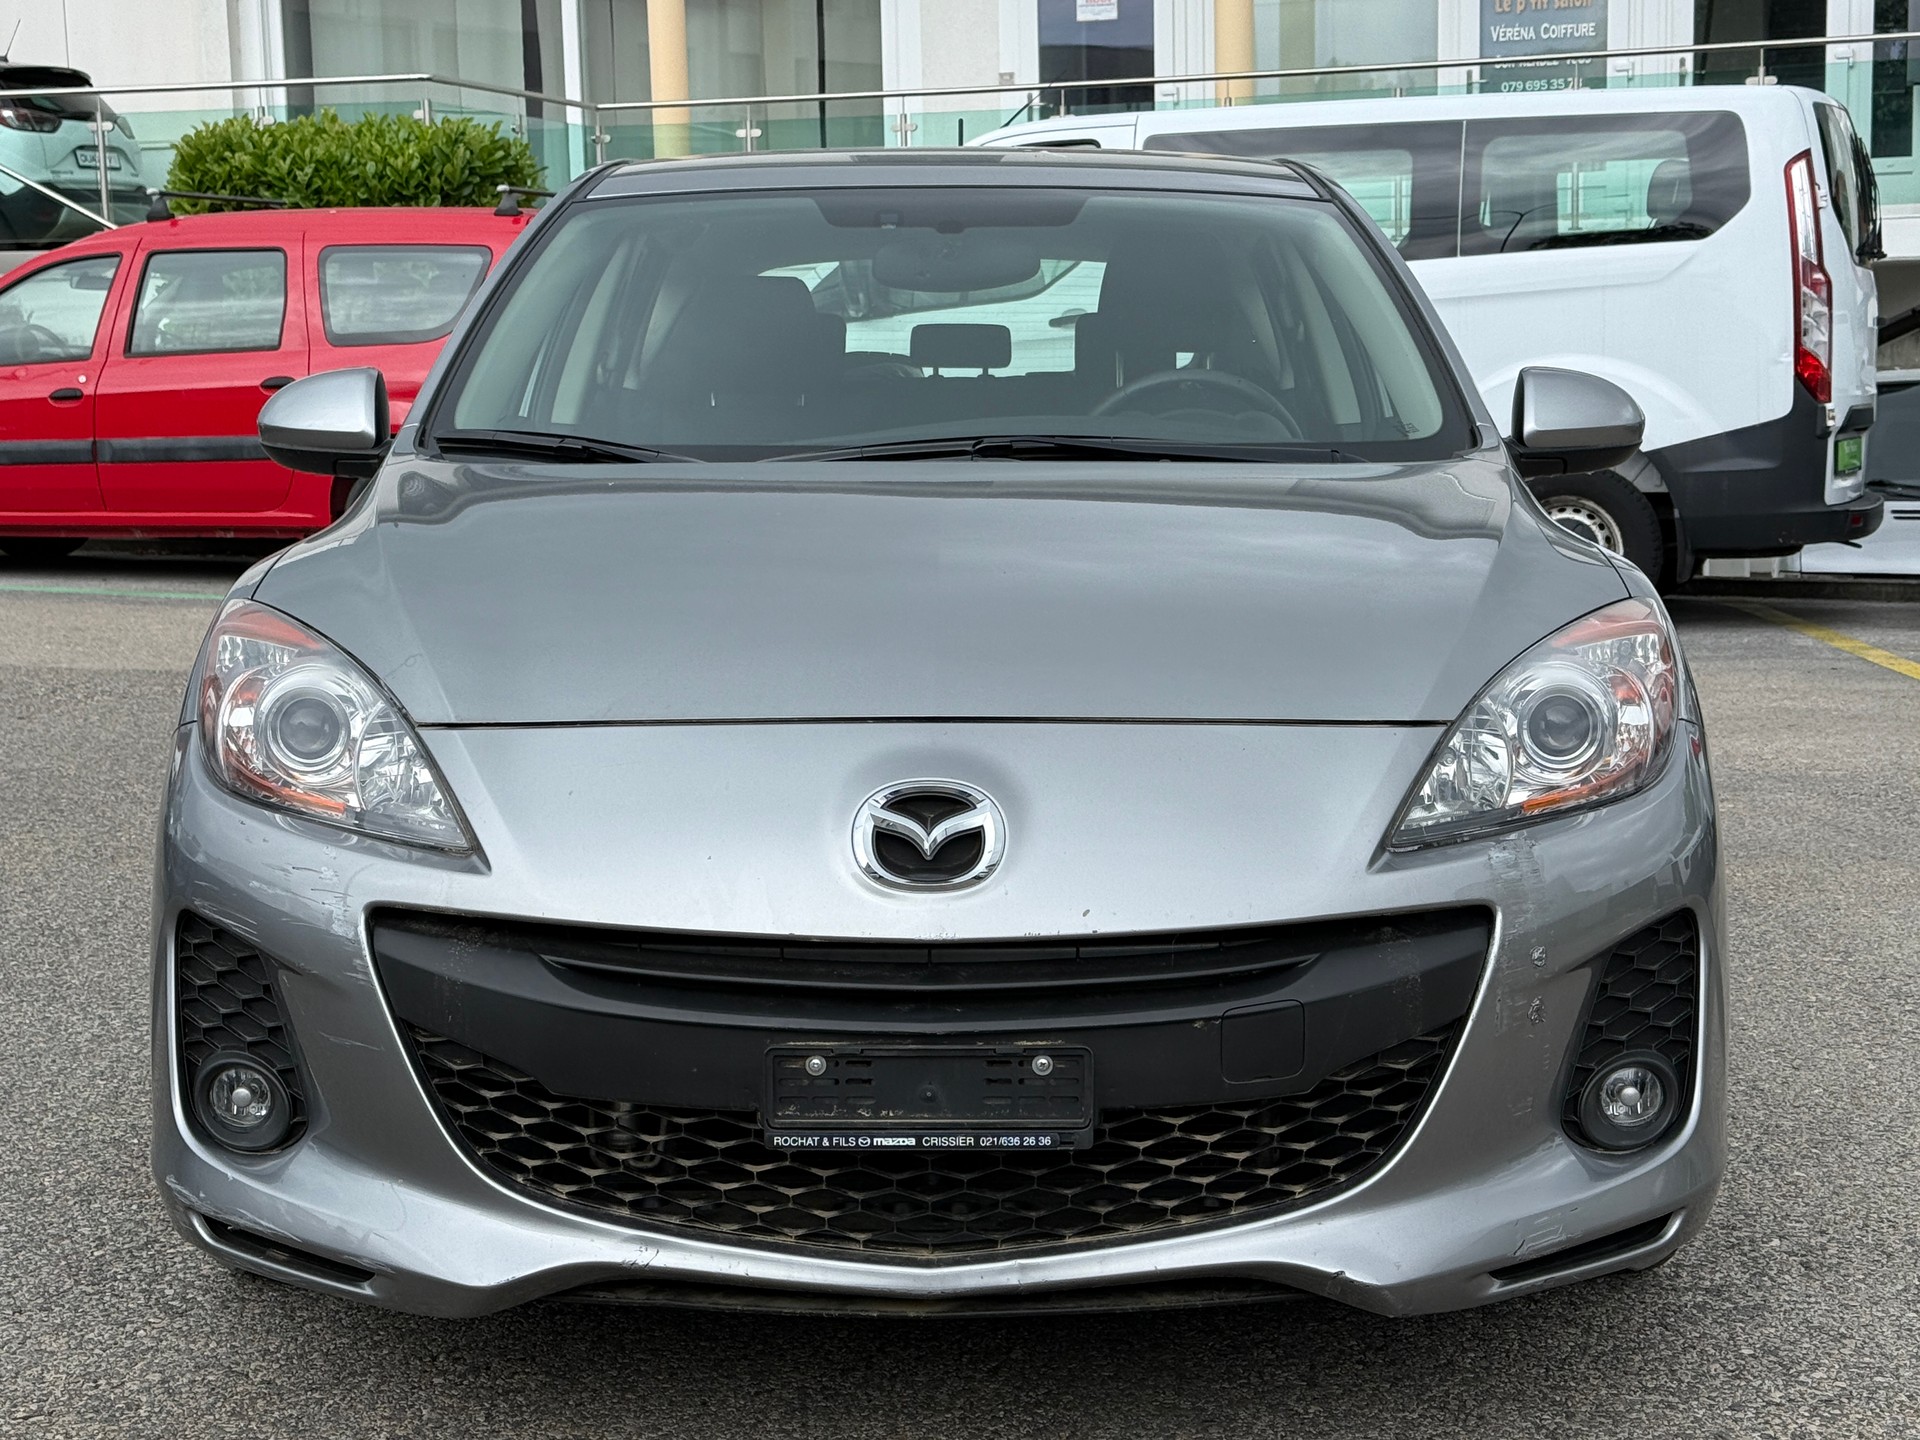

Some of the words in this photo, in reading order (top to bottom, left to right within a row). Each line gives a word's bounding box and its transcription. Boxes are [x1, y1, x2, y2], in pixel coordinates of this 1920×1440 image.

[1495, 0, 1511, 14] Le
[1516, 0, 1549, 15] ptit
[1491, 23, 1535, 41] VÉRÉNA
[1541, 22, 1596, 39] COIFFURE
[1501, 81, 1523, 92] 079
[1525, 79, 1548, 90] 695
[1549, 78, 1565, 89] 35
[773, 1135, 819, 1146] ROCHAT
[822, 1135, 829, 1146] &
[833, 1136, 856, 1147] FILS
[873, 1137, 916, 1146] mazda
[922, 1136, 975, 1147] CRISSIER
[979, 1136, 1021, 1147] 021/636
[1023, 1136, 1036, 1147] 26
[1038, 1136, 1051, 1147] 36
